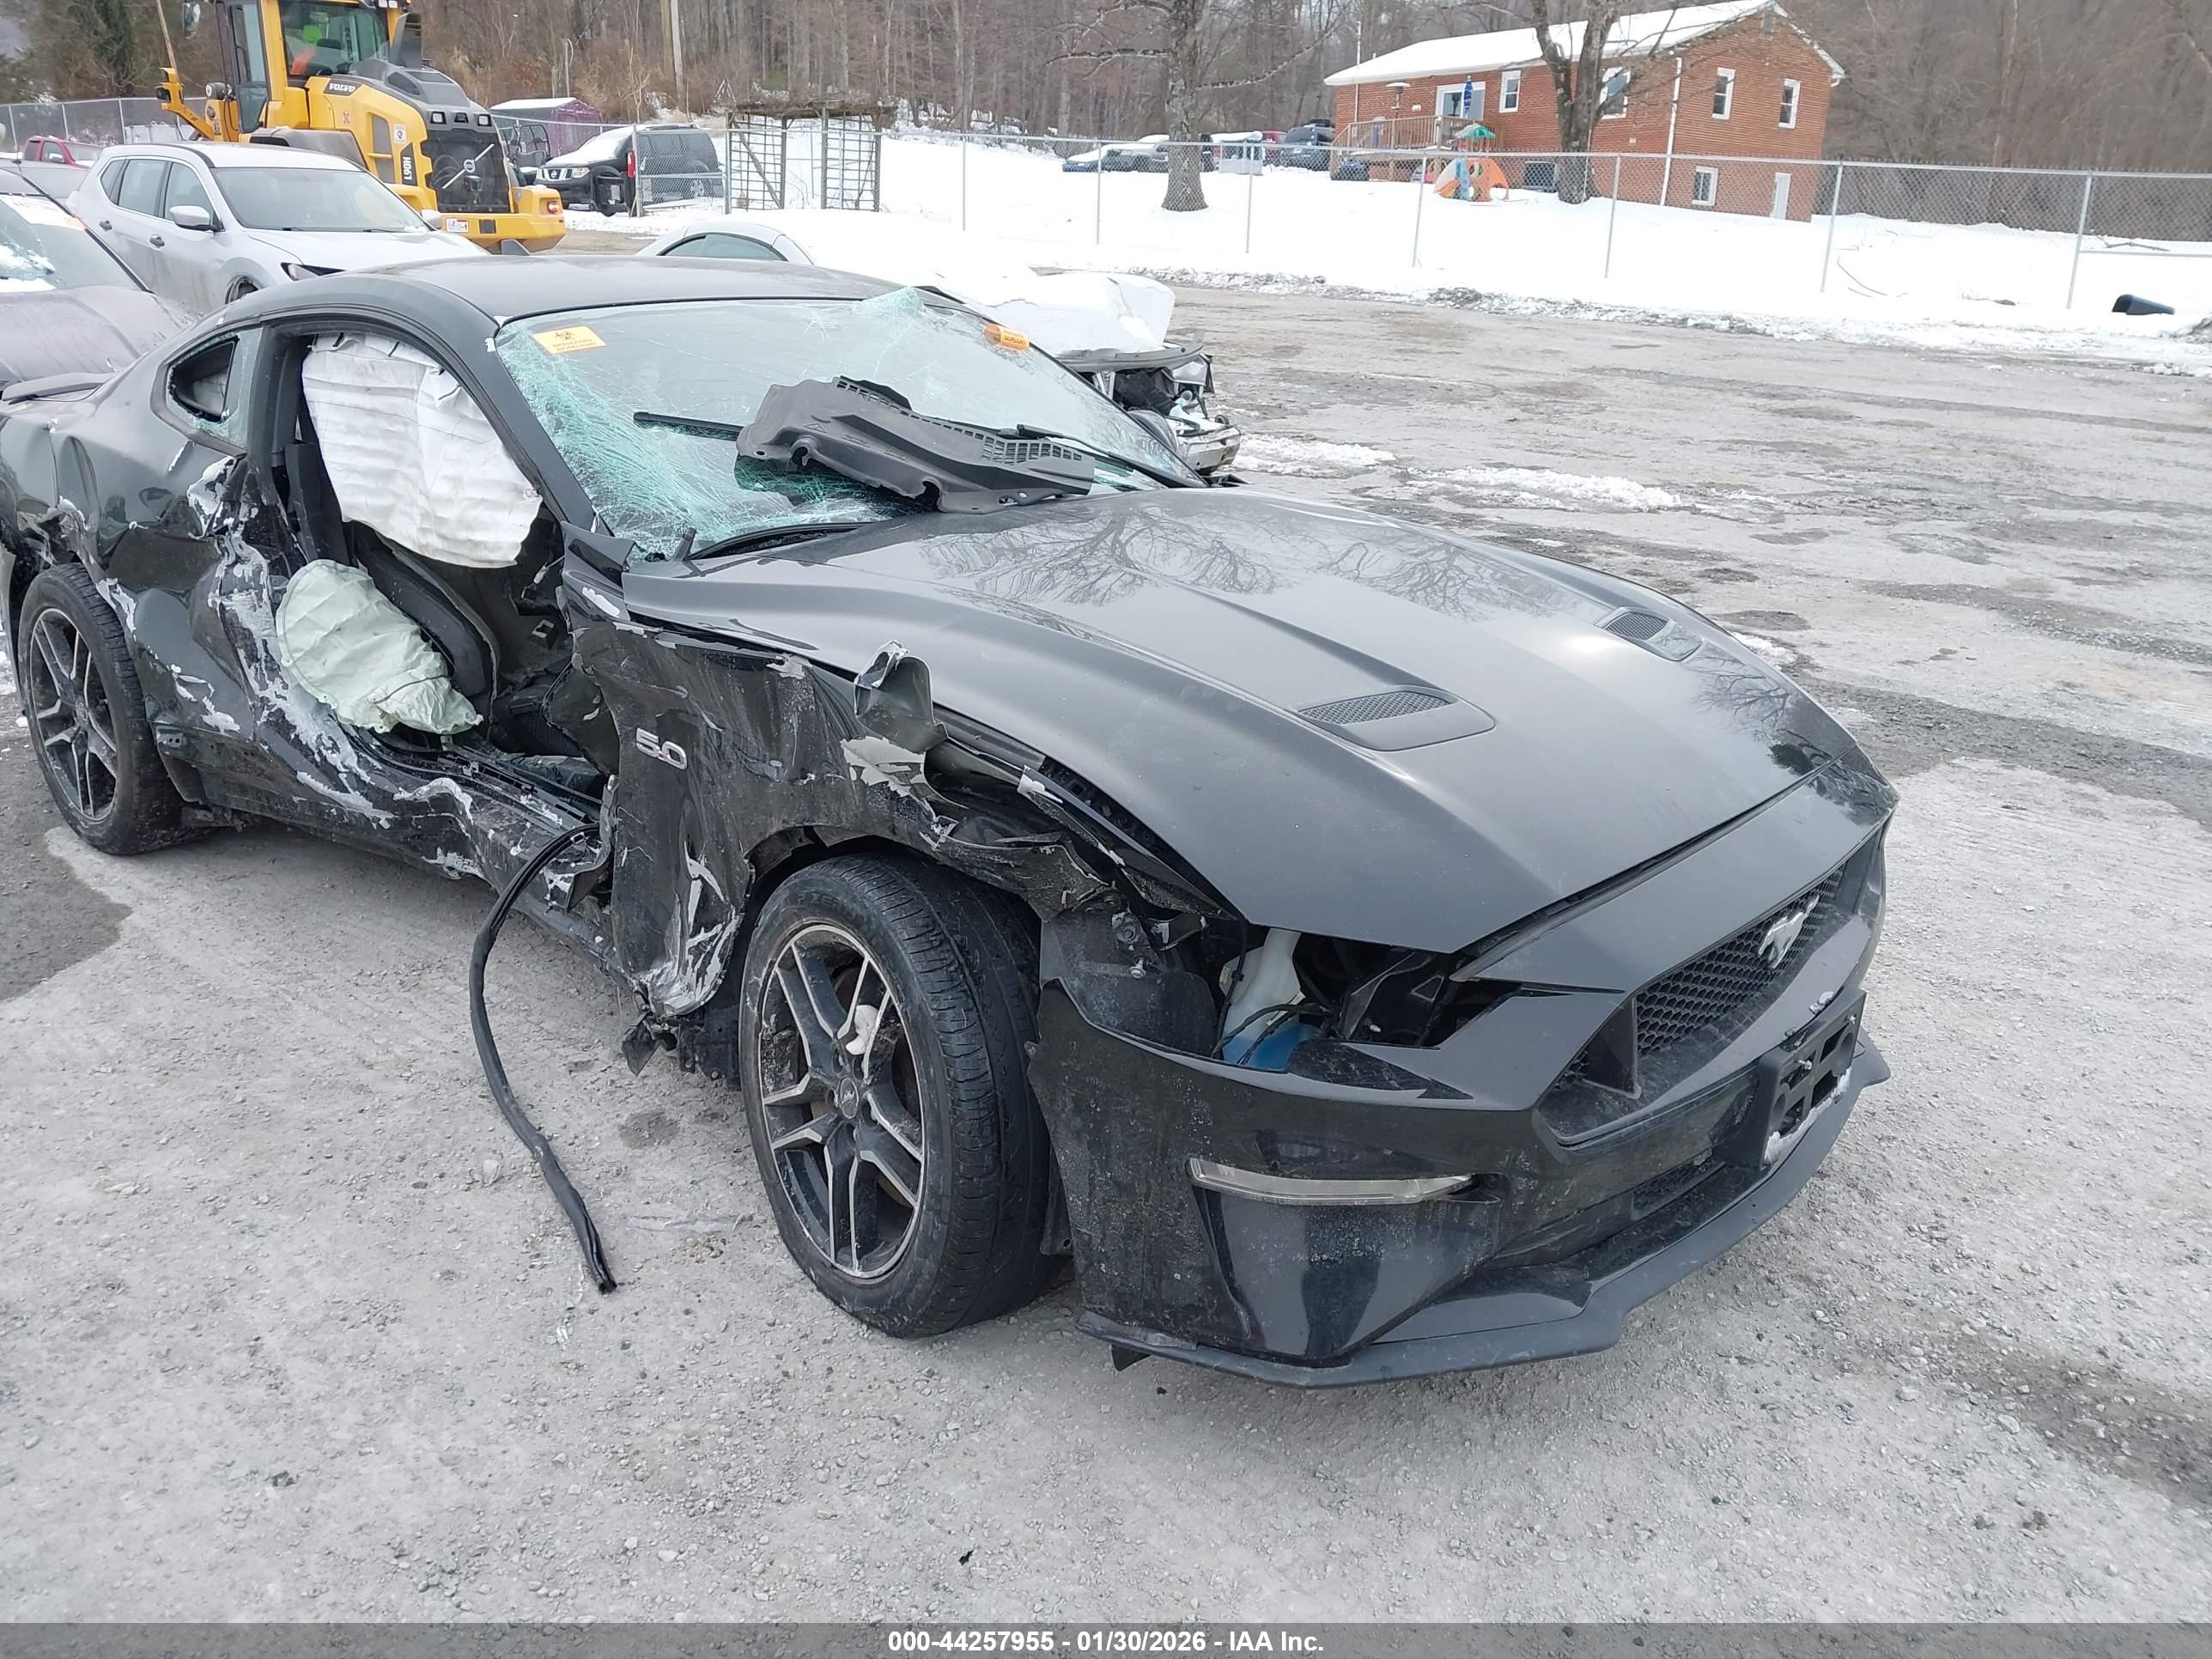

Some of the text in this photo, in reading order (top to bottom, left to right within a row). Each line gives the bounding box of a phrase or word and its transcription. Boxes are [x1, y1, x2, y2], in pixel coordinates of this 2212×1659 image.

[329, 82, 356, 93] VOLVO
[402, 156, 413, 180] L90H
[635, 727, 688, 770] 5.0
